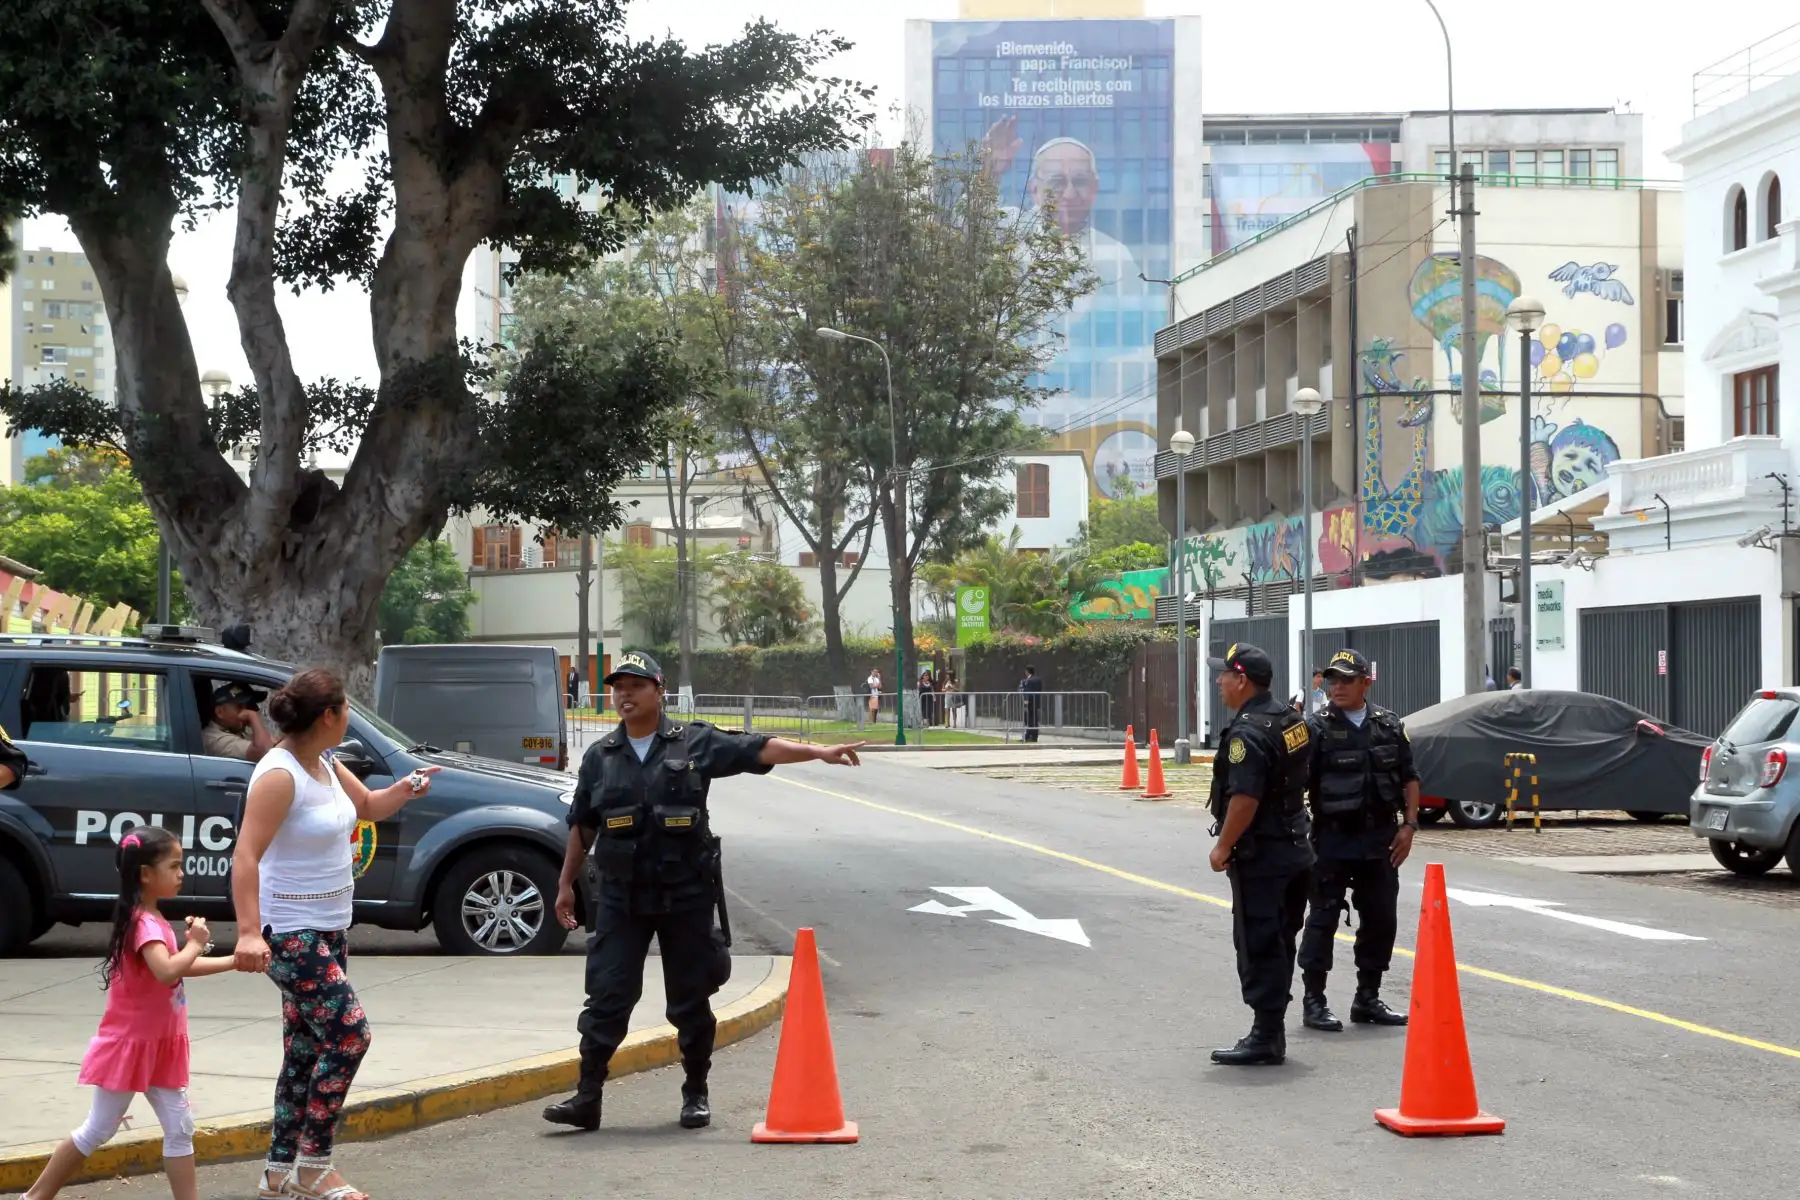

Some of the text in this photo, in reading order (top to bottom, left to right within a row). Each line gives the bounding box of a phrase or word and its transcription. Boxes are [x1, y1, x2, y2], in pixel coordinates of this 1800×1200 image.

[996, 41, 1078, 58] ¡Bienvenido,
[1021, 55, 1133, 73] papa Francisco!
[1012, 78, 1132, 92] Te recibimos con
[978, 92, 1114, 107] los brazos abiertos
[1538, 588, 1552, 599] media
[1538, 602, 1561, 612] networks
[185, 855, 232, 877] COLO
